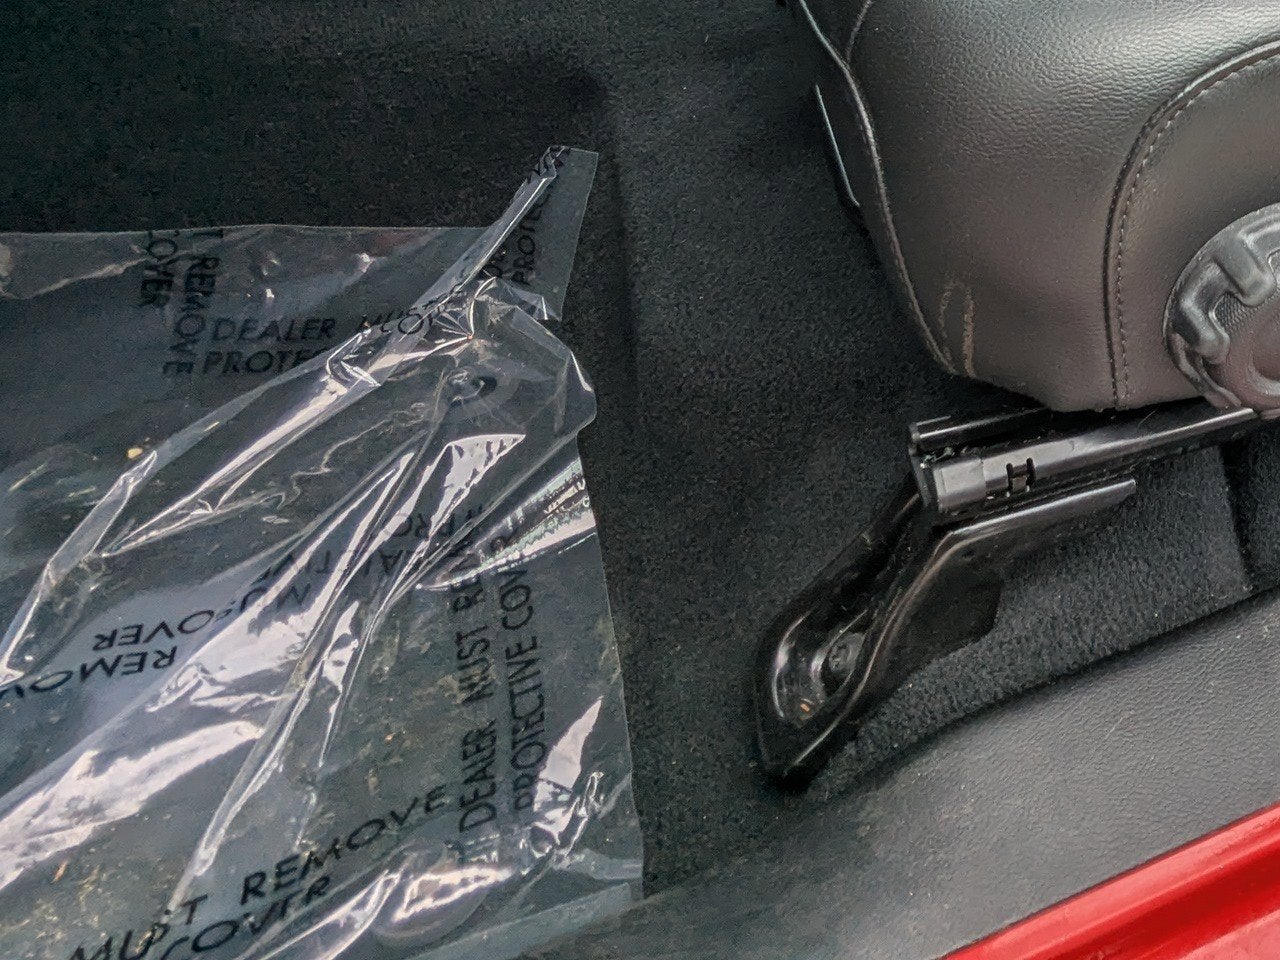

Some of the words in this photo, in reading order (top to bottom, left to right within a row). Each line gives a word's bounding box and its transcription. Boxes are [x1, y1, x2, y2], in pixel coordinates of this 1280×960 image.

[212, 317, 336, 343] DEALER
[459, 719, 498, 833] DEALER
[239, 785, 447, 906] REMOVE
